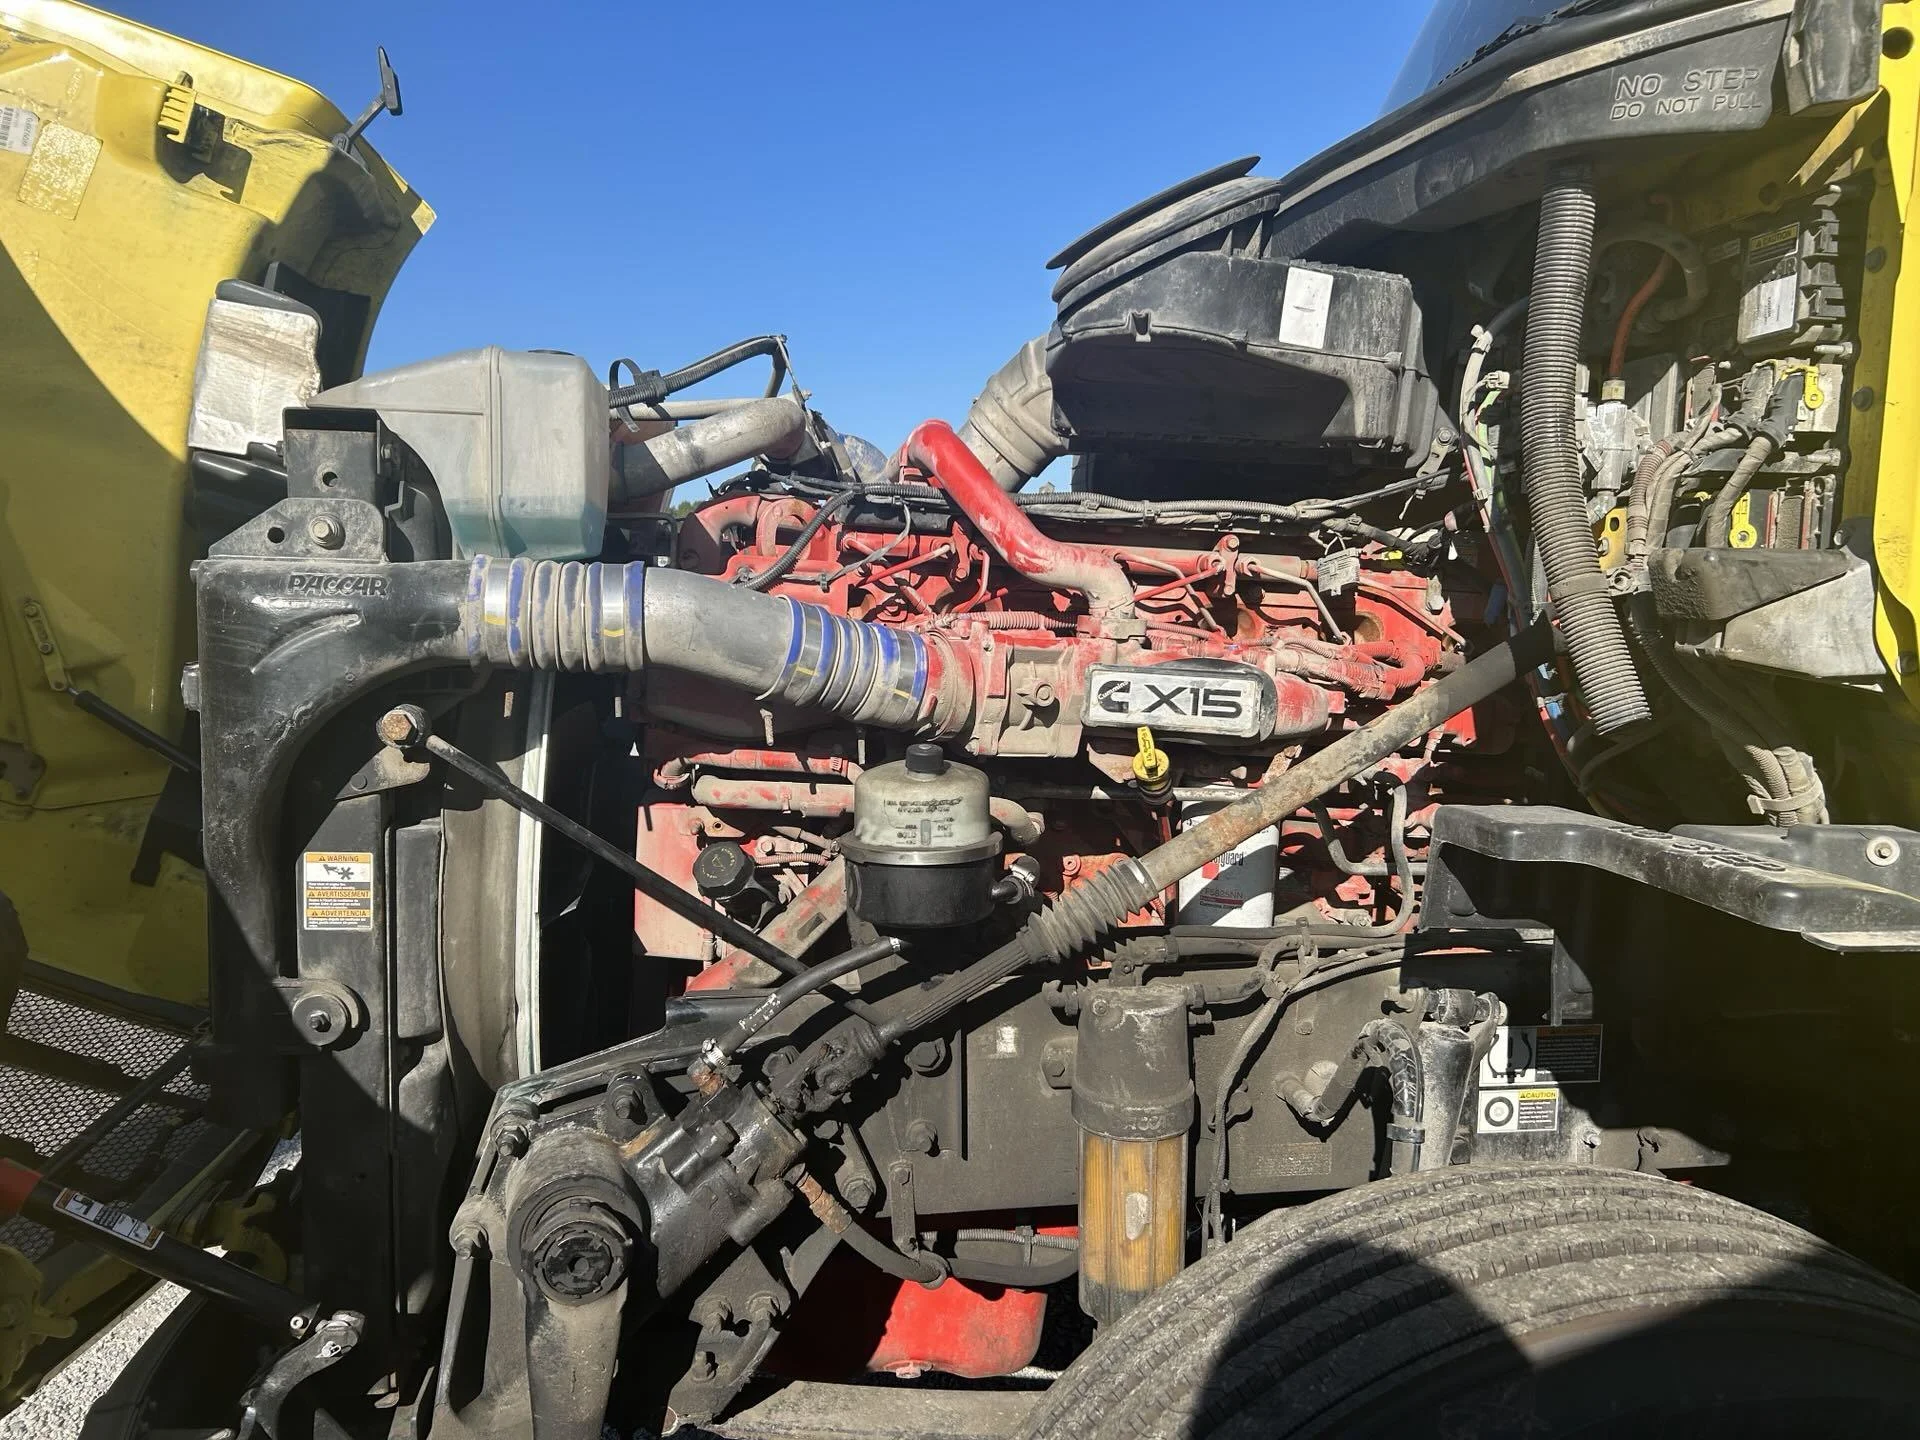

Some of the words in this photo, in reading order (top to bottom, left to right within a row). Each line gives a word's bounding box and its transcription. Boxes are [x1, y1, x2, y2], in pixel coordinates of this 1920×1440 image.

[1614, 73, 1663, 100] NO
[1683, 67, 1761, 92] STEP
[1610, 102, 1643, 120] DO
[1656, 96, 1701, 116] NOT
[1712, 94, 1763, 112] PULL
[286, 573, 389, 597] PACCAR
[1097, 681, 1129, 700] Cummins
[1141, 683, 1243, 719] X15
